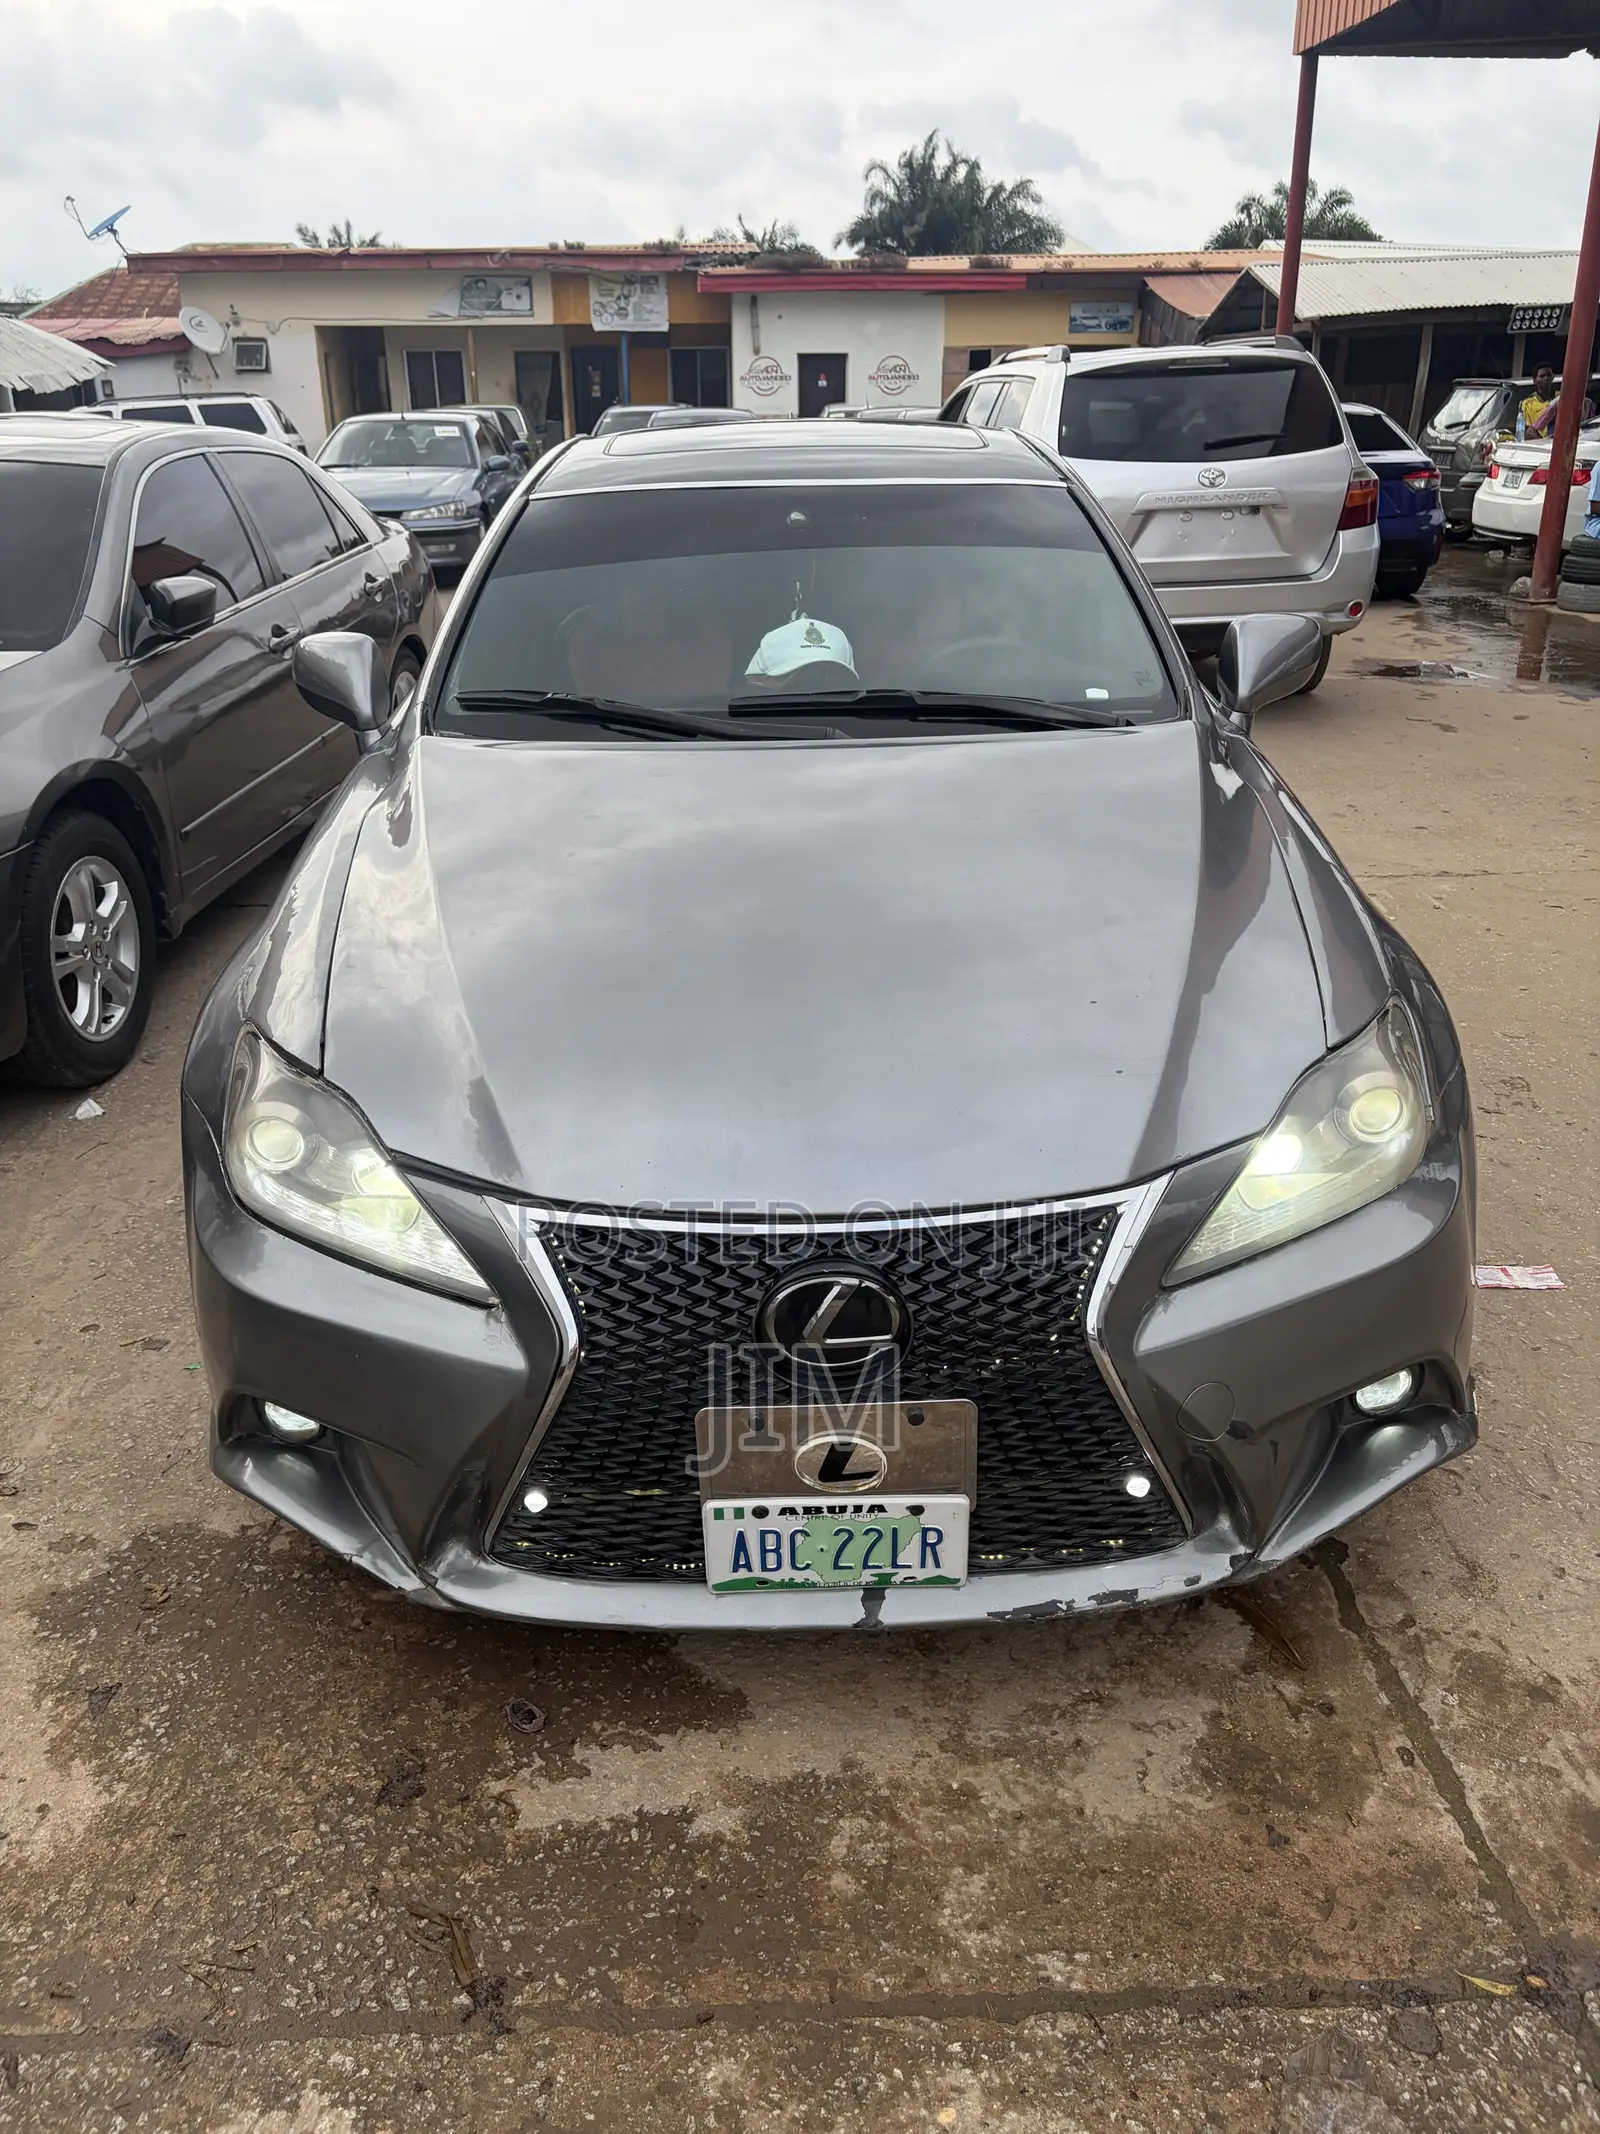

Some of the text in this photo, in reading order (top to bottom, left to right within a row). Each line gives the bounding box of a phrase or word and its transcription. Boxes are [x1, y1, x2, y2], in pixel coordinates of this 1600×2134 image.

[1154, 492, 1271, 505] HIGHLANDER
[777, 1504, 888, 1516] ABUJA
[731, 1525, 944, 1573] ABC 22LR
